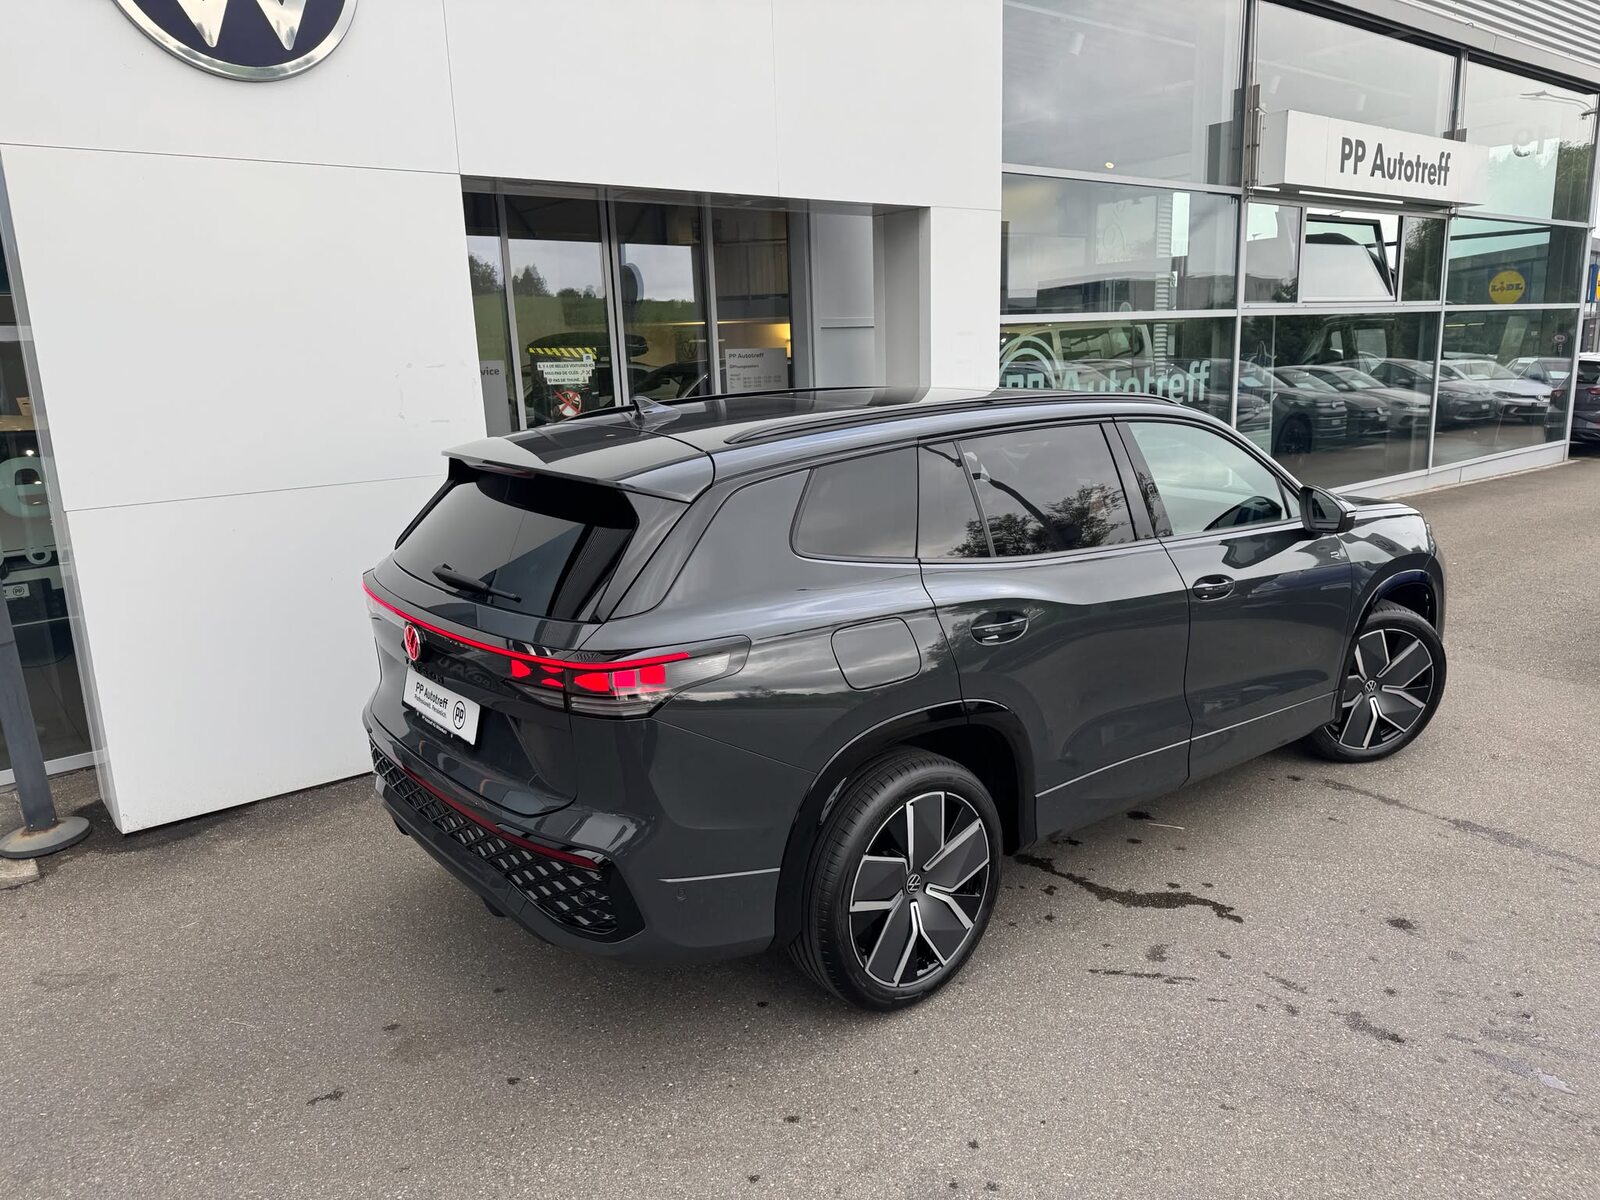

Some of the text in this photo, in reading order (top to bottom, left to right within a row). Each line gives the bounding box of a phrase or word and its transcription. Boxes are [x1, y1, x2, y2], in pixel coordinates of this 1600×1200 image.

[1340, 136, 1451, 187] PP Autotreff
[415, 681, 449, 710] PP Autotreff
